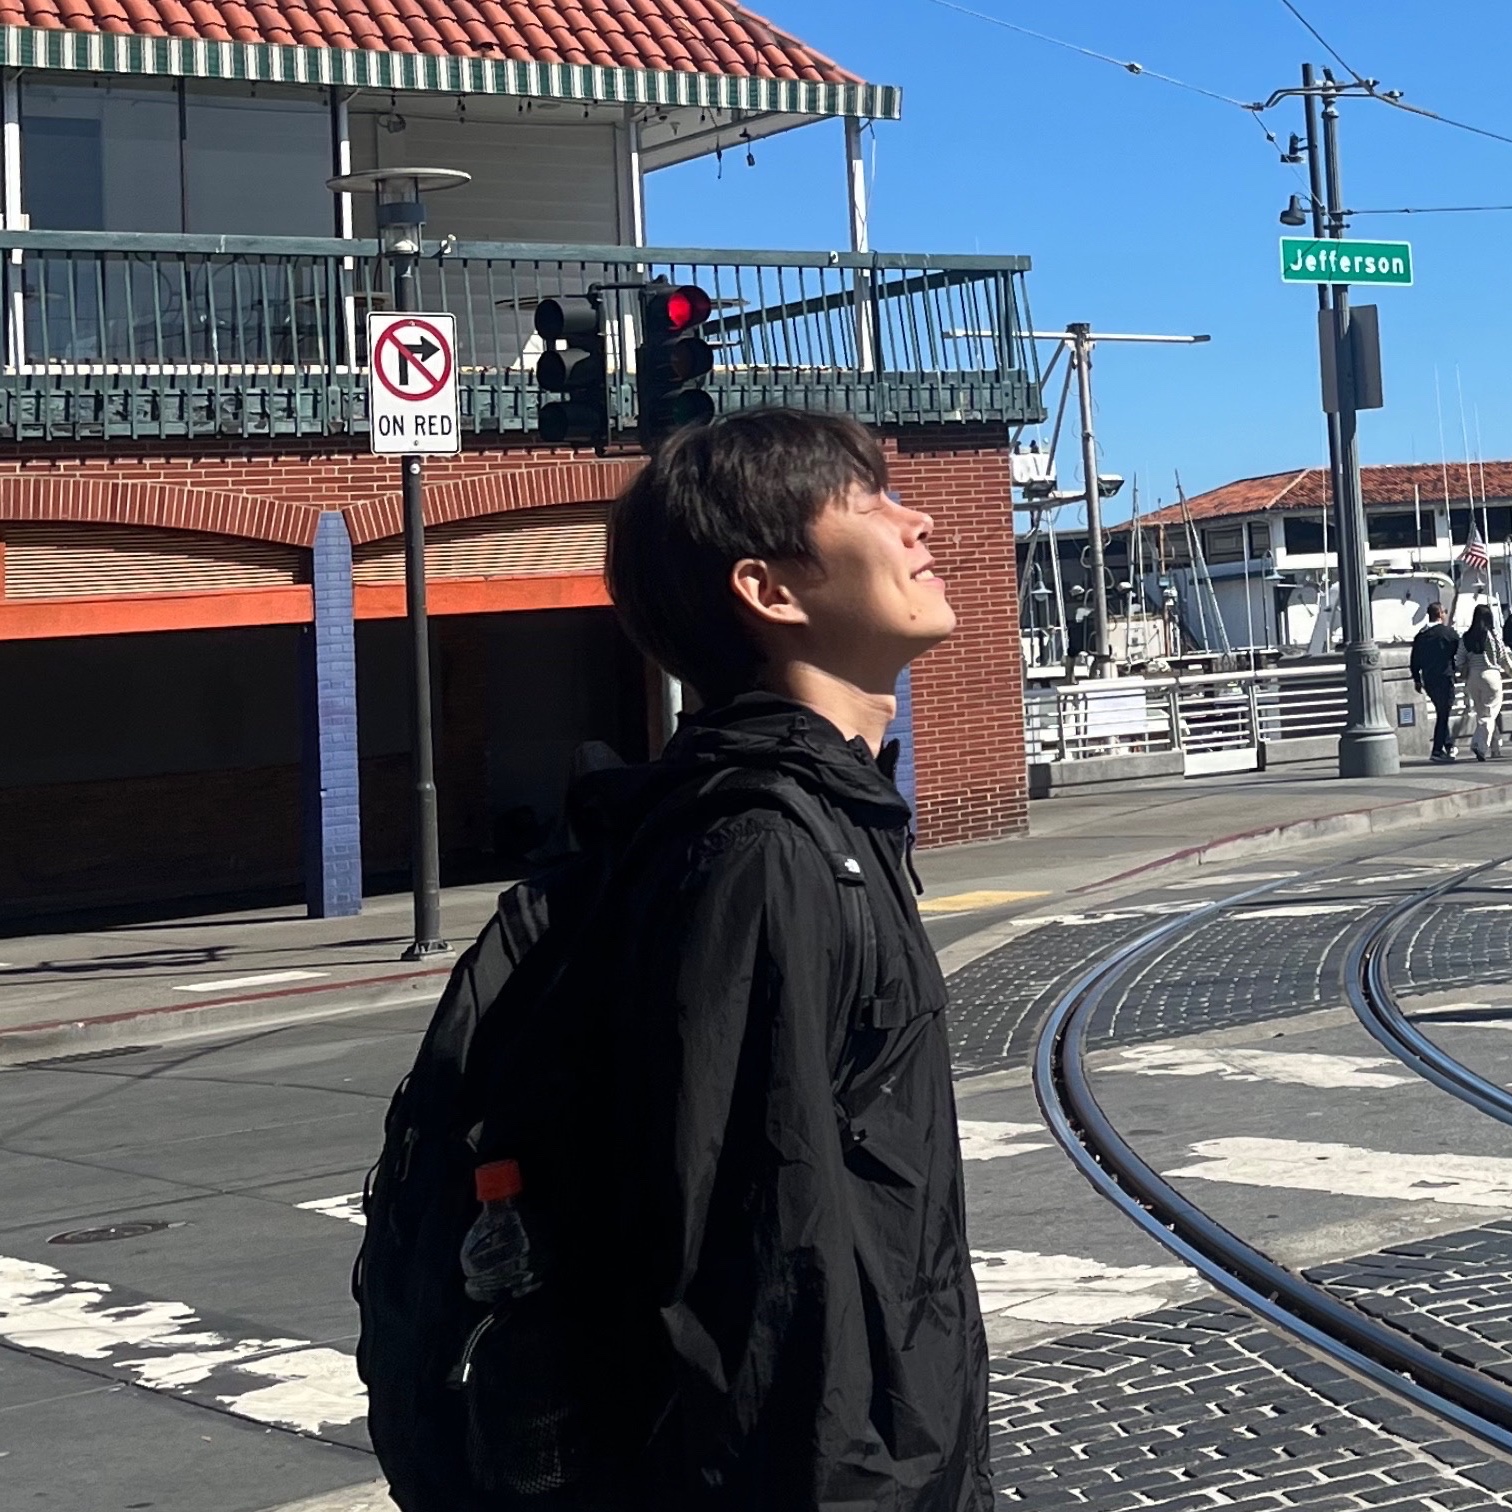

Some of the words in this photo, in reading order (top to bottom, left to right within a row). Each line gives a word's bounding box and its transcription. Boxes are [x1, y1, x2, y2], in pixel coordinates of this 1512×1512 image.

[1289, 248, 1404, 274] Jefferson
[378, 414, 404, 436] ON
[414, 414, 452, 436] RED
